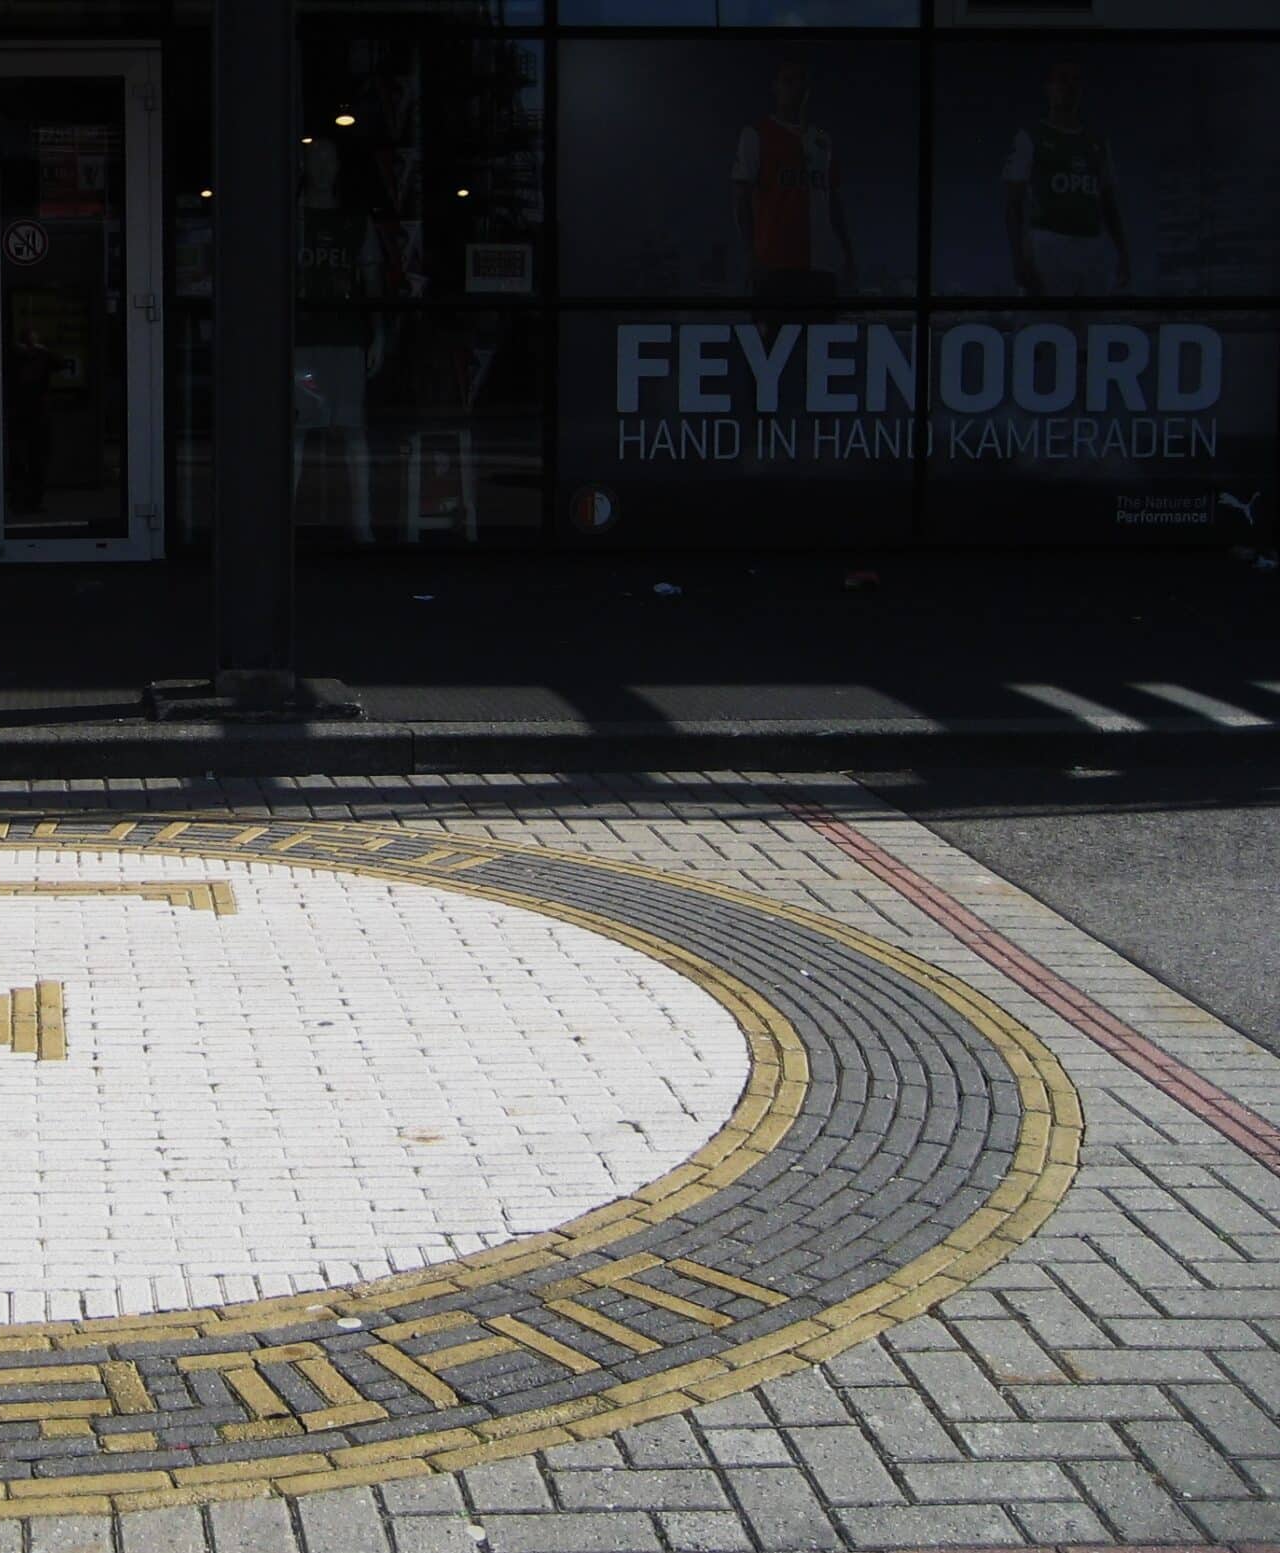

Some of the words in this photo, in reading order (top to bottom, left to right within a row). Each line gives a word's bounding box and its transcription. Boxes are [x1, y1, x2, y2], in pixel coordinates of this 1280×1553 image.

[616, 323, 1223, 413] FEYENOORD
[618, 419, 740, 460] HAND
[756, 419, 796, 460] IN
[949, 418, 1217, 460] KAMERADEN
[1117, 495, 1140, 509] The
[1145, 495, 1190, 509] Nature
[1194, 495, 1207, 509] of
[1116, 510, 1208, 524] Performance
